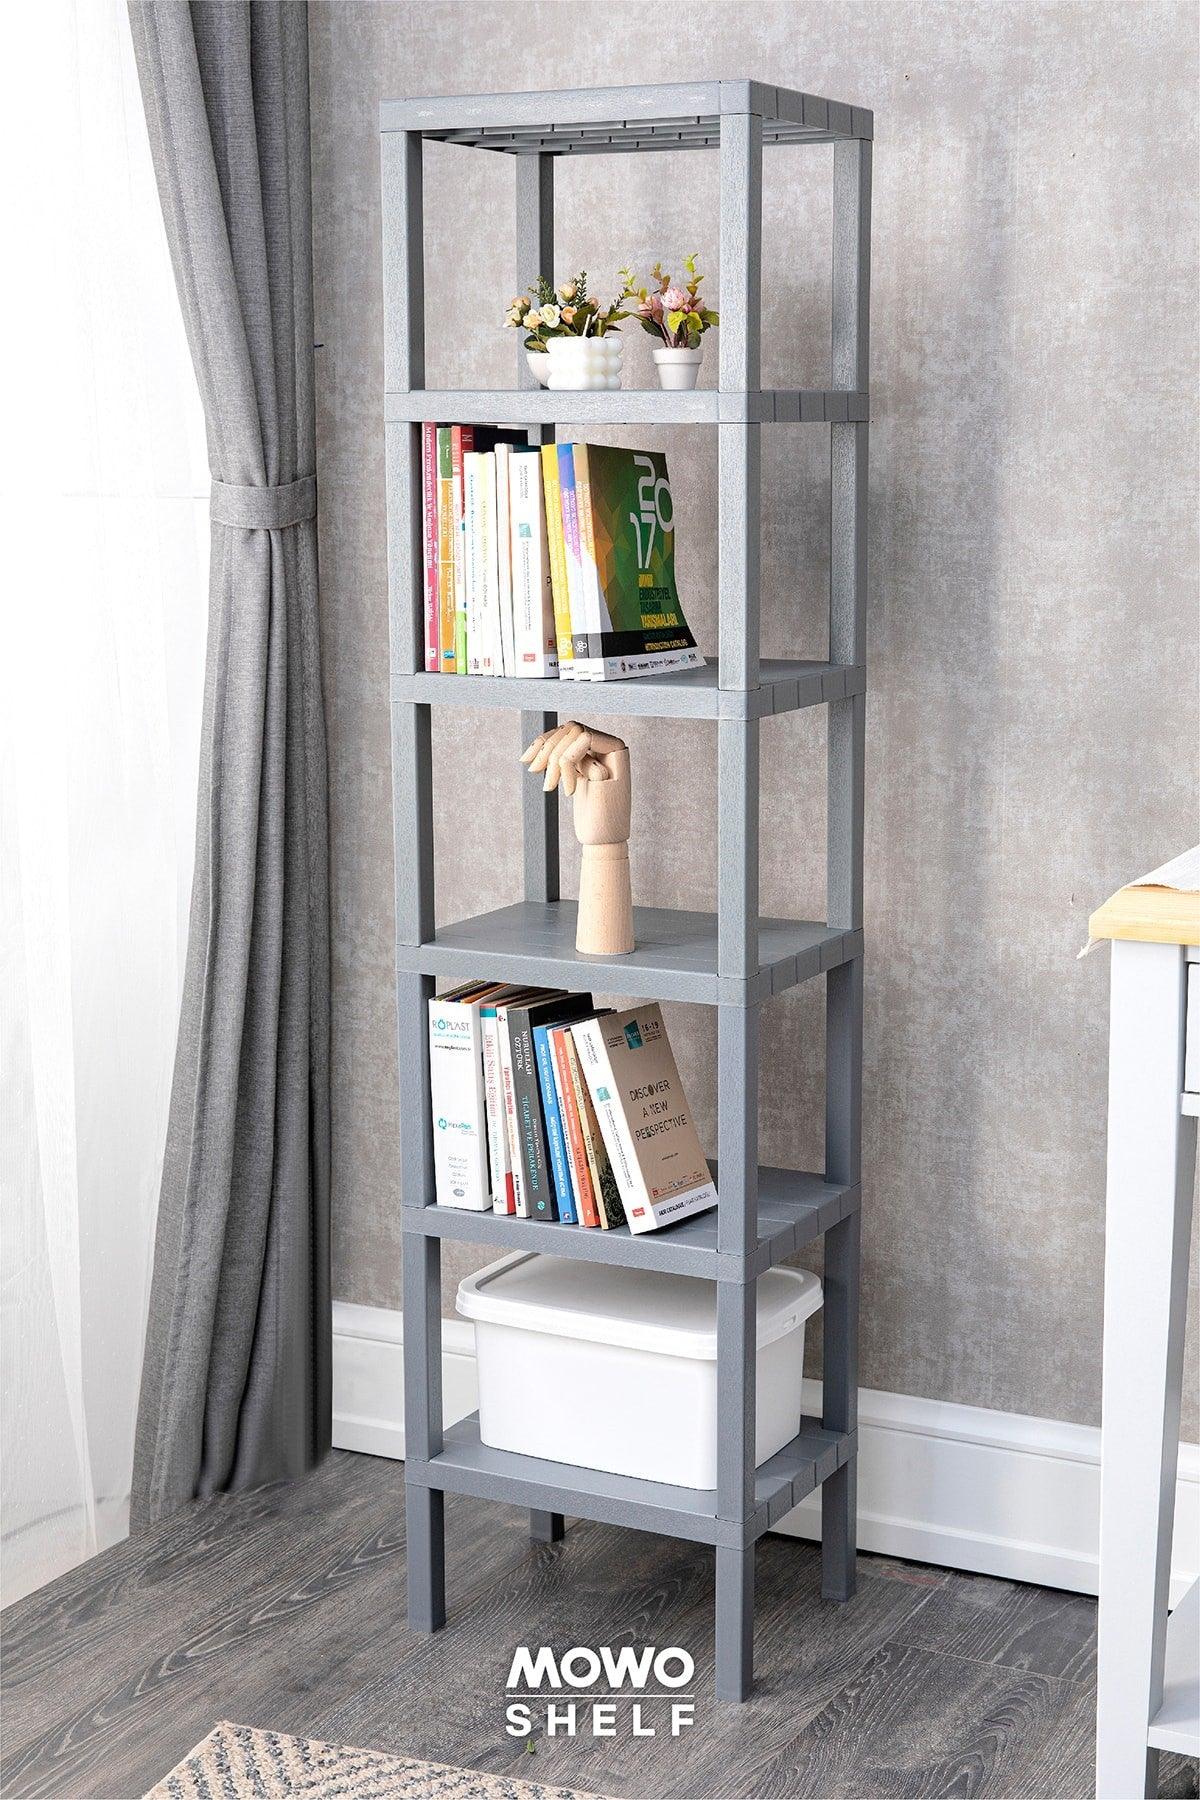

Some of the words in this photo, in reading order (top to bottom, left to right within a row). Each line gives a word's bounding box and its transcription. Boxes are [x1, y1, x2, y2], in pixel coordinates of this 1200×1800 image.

[512, 1036, 525, 1070] ÖZTÜRK
[519, 1030, 534, 1075] NURULLAH
[629, 1079, 671, 1102] DISCOVER
[519, 1095, 533, 1129] TİCARET
[643, 1107, 649, 1118] A
[649, 1100, 668, 1115] NEW
[635, 1113, 687, 1141] PERSPECTIVE
[524, 1142, 541, 1191] PERAKENDE
